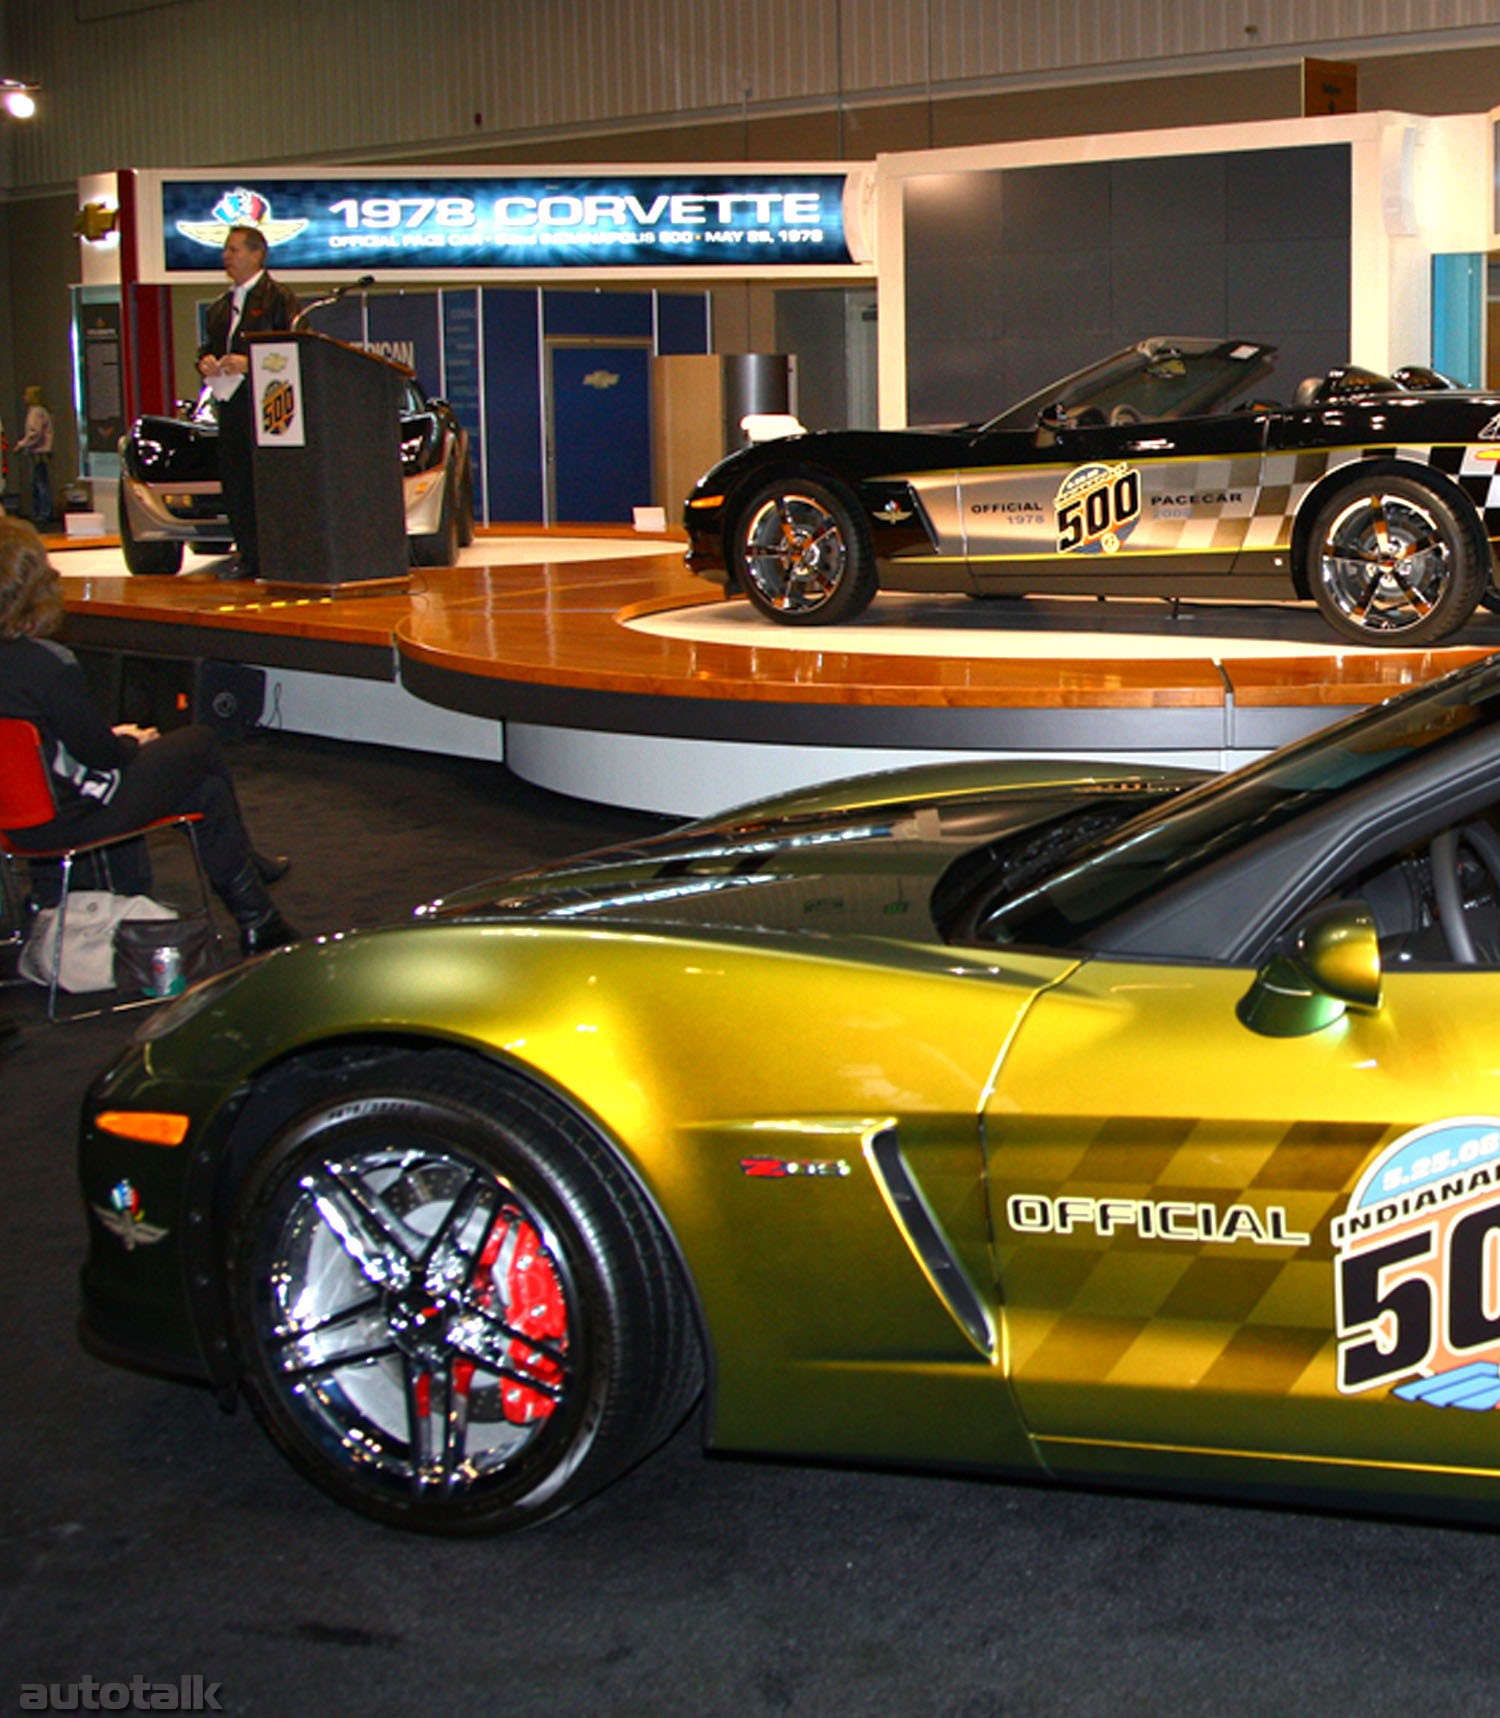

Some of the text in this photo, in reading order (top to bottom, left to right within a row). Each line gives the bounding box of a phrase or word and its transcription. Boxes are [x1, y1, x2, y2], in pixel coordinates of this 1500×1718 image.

[329, 193, 820, 228] 1978 CORVETTE
[329, 235, 399, 247] OFFICIAL
[706, 231, 744, 244] MAY
[263, 386, 294, 432] 500
[971, 502, 1044, 514] OFFICIAL
[1057, 471, 1139, 551] 500
[1151, 493, 1243, 506] PACECAR
[1382, 1132, 1500, 1192] 5.25.08
[1008, 1195, 1309, 1245] OFFICIAL
